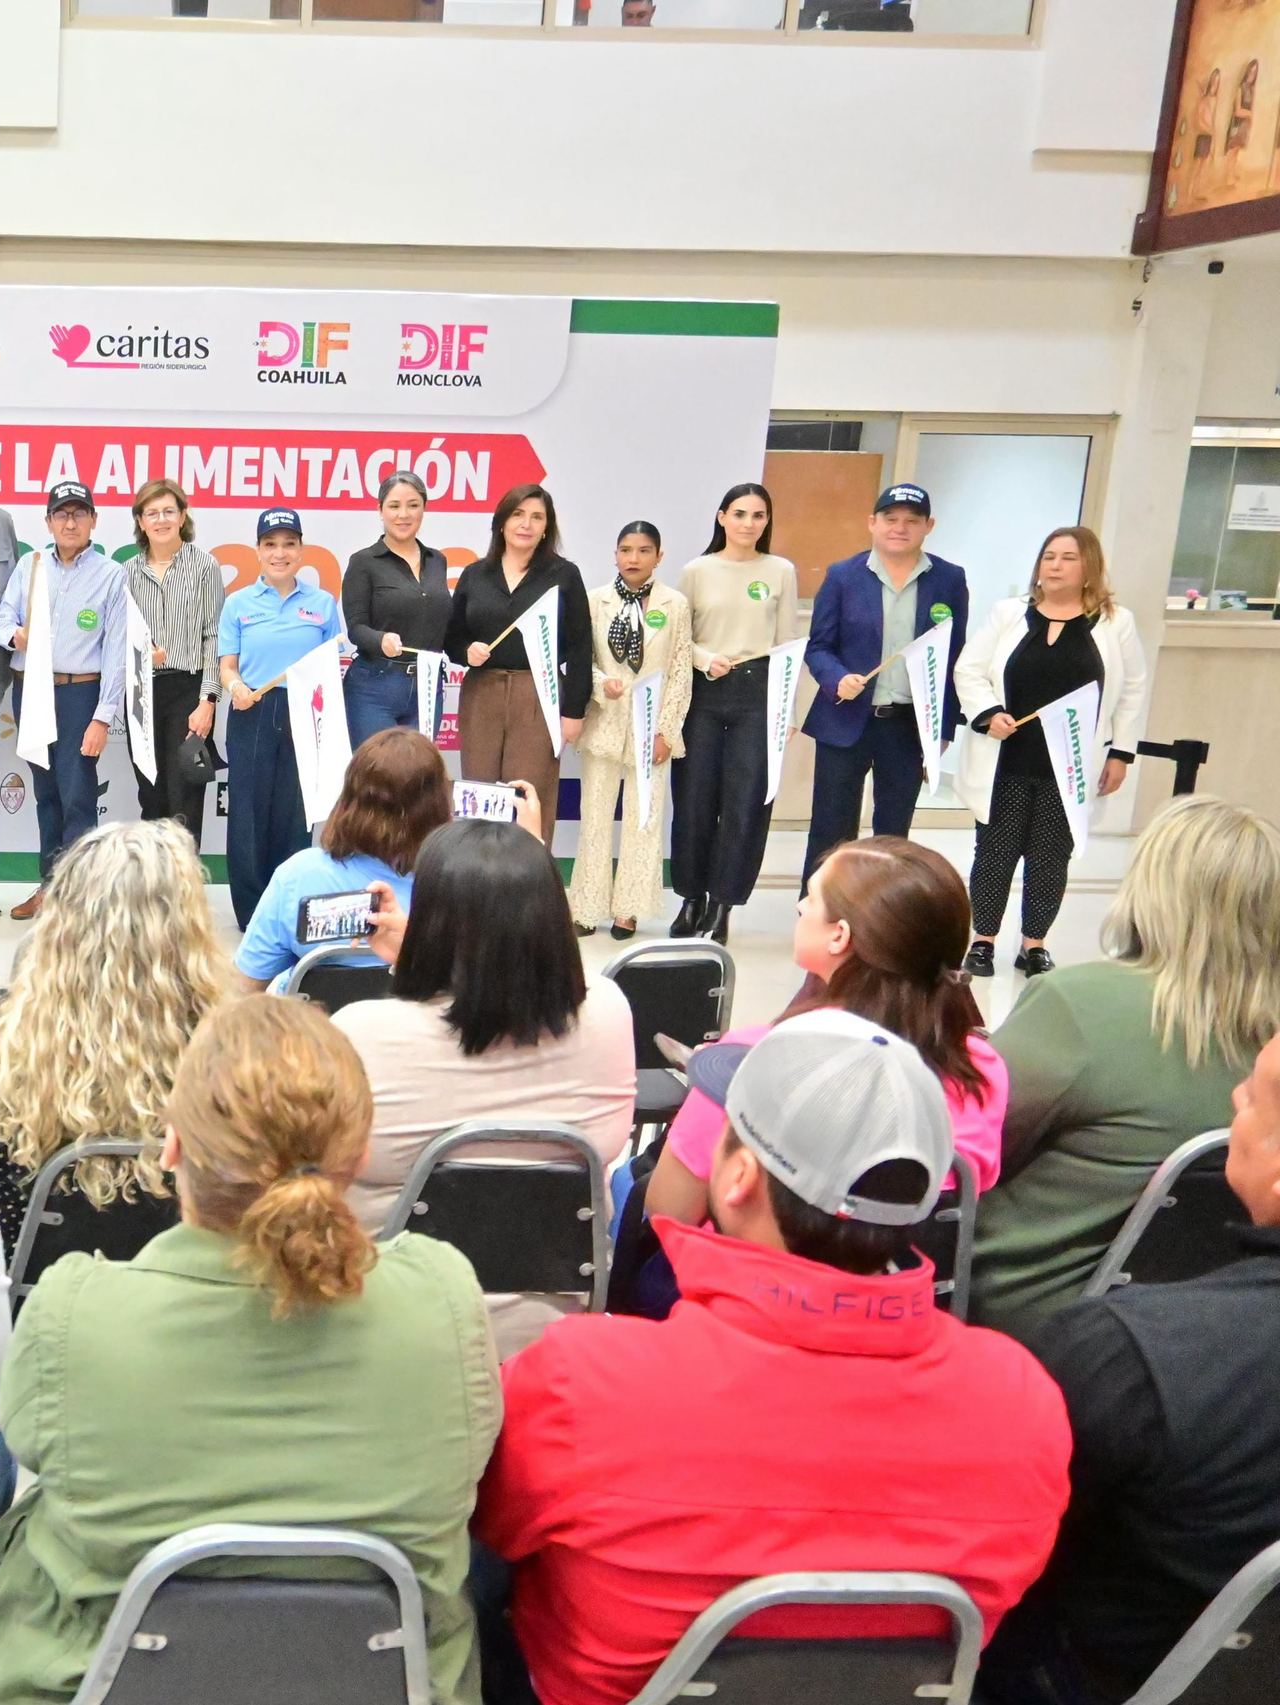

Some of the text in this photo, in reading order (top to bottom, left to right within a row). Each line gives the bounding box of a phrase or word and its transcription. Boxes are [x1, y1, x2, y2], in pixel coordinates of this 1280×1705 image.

[96, 325, 210, 360] cáritas
[257, 321, 351, 368] DIF
[398, 323, 488, 371] DIF
[257, 370, 347, 385] COAHUILA
[396, 373, 482, 387] MONCLOVA
[14, 442, 83, 493] LA
[539, 614, 558, 705] Alimenta
[778, 655, 793, 752] Alimenta
[927, 645, 939, 741] Alimenta
[1066, 708, 1086, 804] Alimenta
